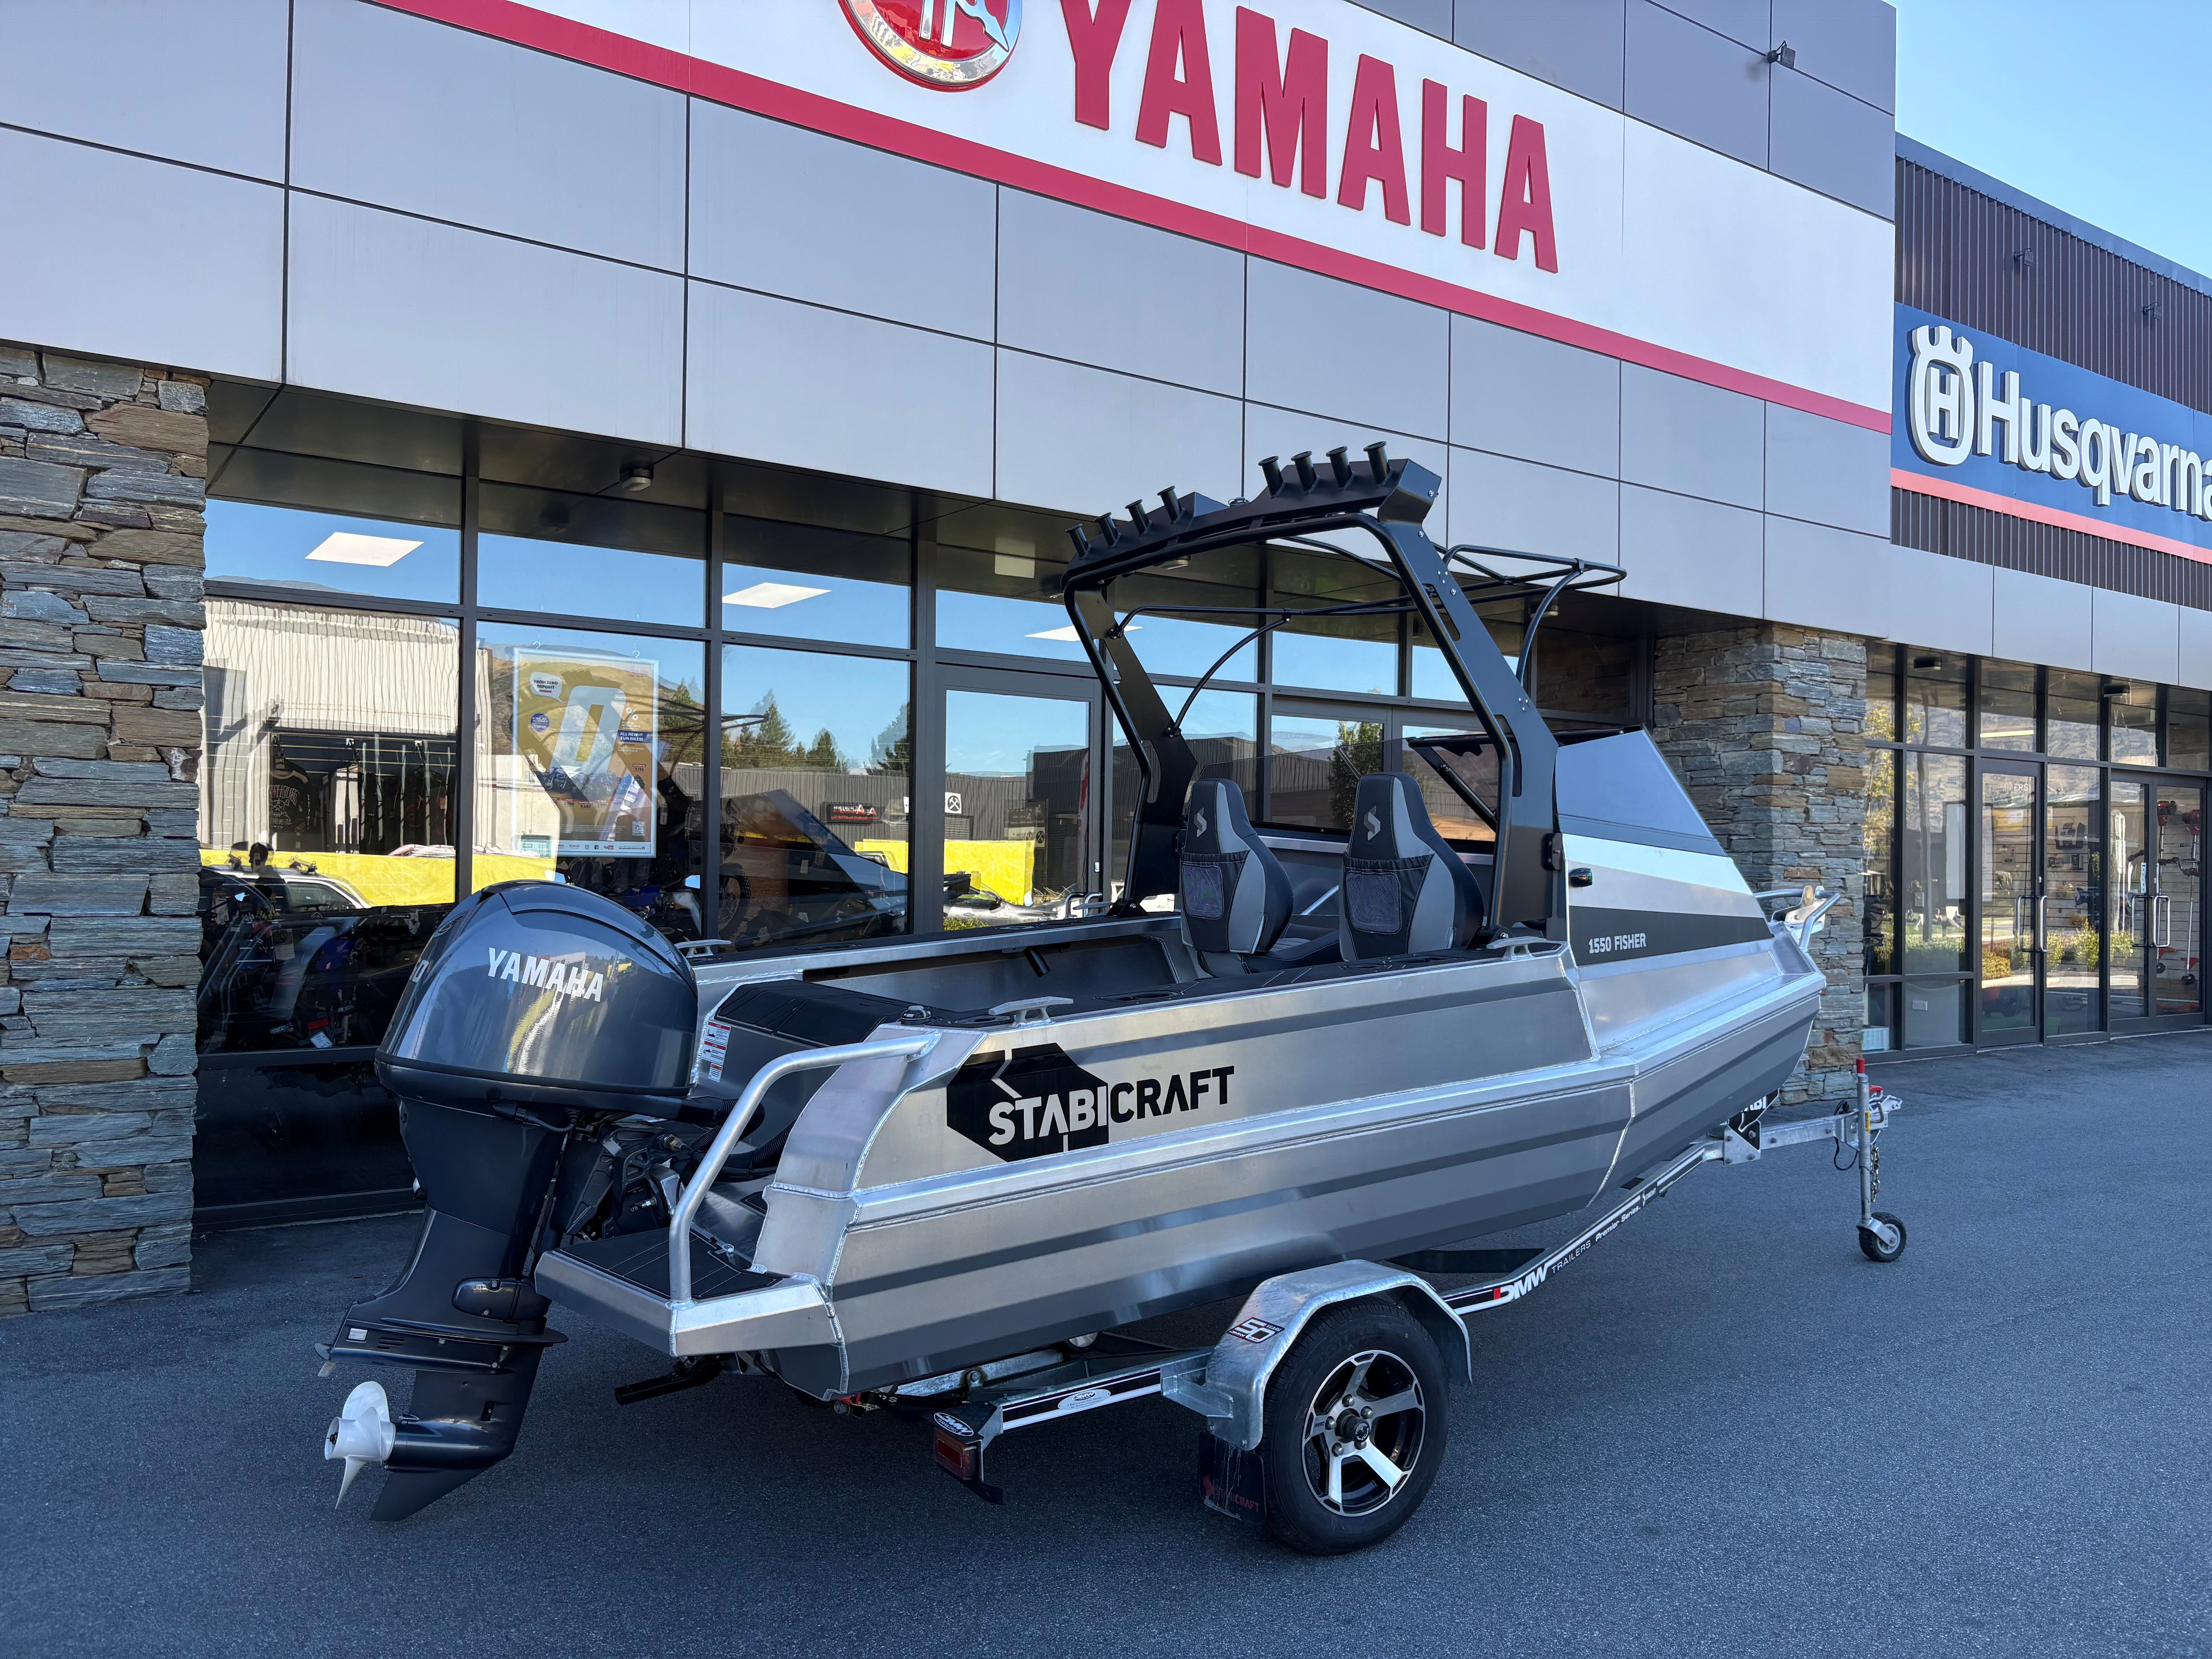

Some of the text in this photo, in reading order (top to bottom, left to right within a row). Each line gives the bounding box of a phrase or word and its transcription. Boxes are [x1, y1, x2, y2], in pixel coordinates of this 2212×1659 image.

[1059, 0, 1558, 275] YAMAHA
[1989, 783, 2028, 791] TRIMMERS
[1589, 933, 1646, 954] 1550 FISHER
[488, 947, 603, 1002] YAMAHA
[988, 1065, 1235, 1146] STABICRAFT
[1493, 1262, 1549, 1302] DMW
[1551, 1240, 1591, 1274] TRAILERS
[1595, 1220, 1620, 1242] Premier
[1234, 1318, 1275, 1342] 50
